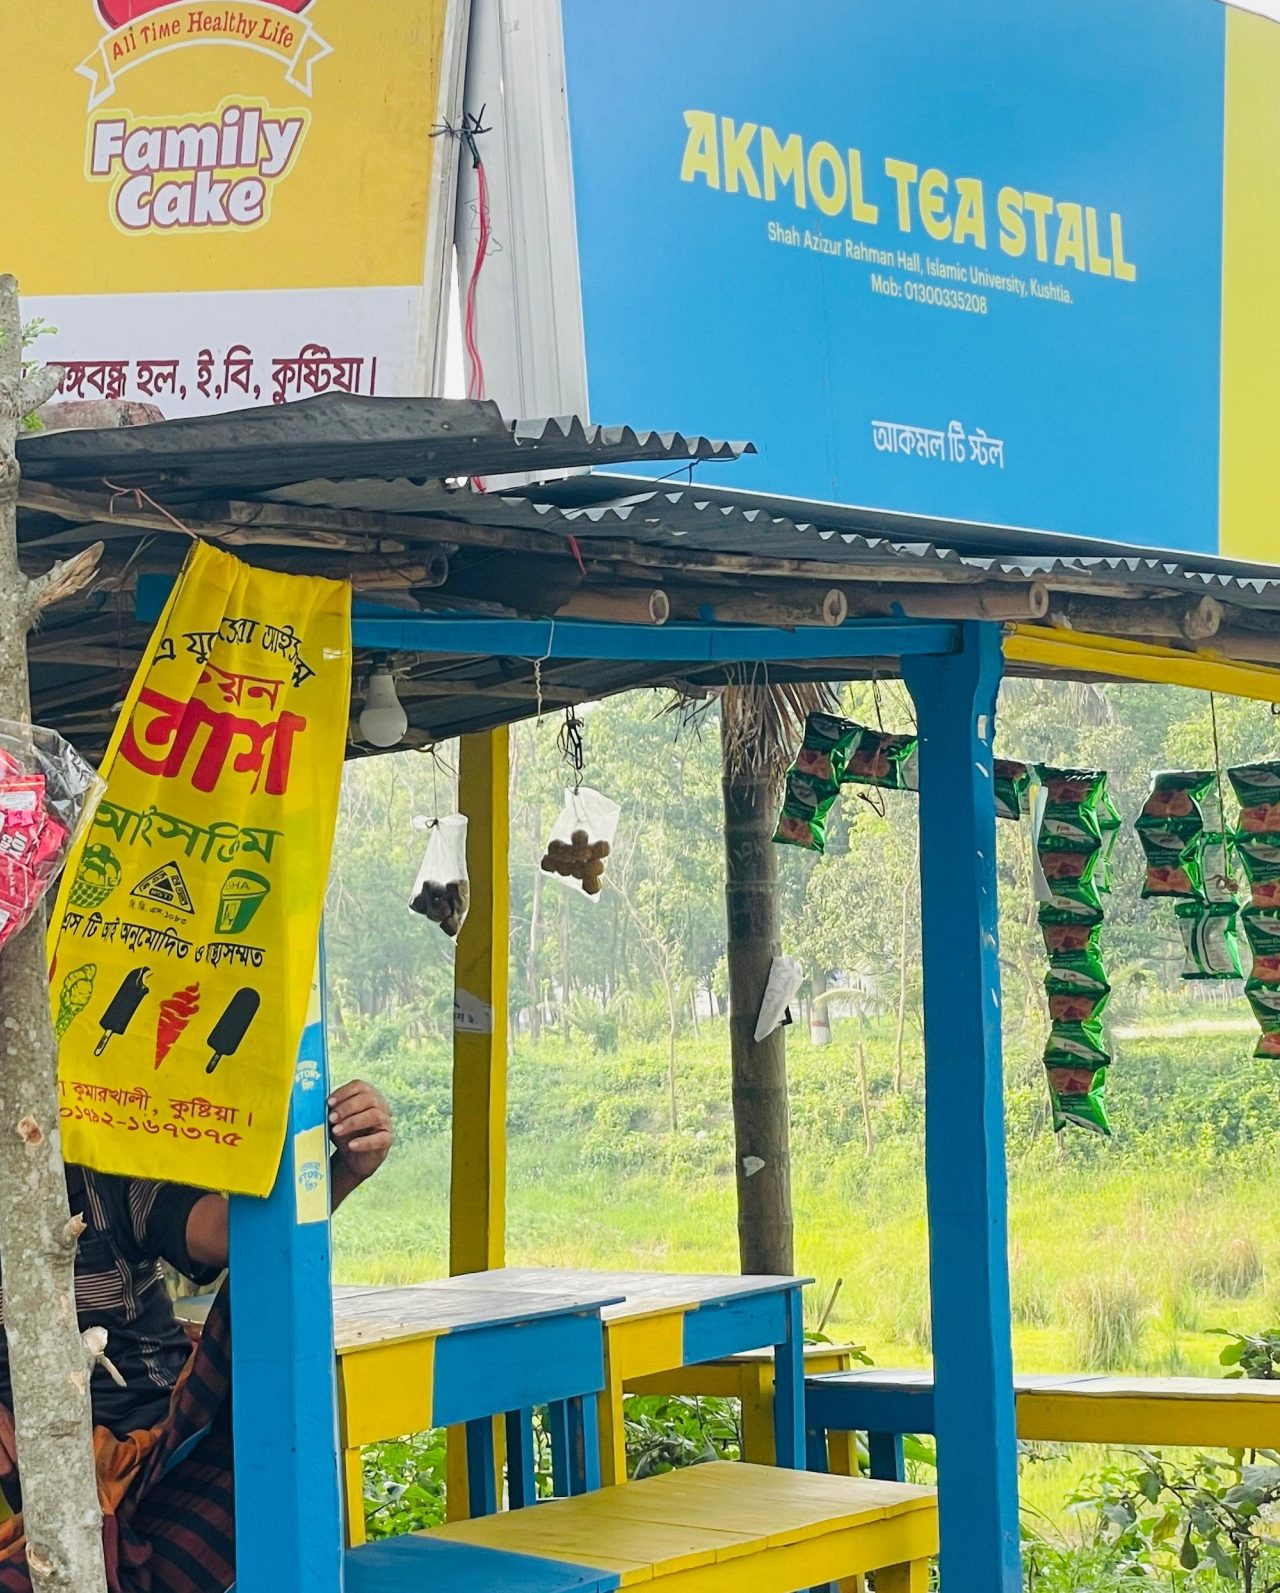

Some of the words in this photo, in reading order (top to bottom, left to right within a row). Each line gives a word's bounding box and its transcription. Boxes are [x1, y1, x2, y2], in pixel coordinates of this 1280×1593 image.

[112, 27, 136, 60] All
[140, 19, 180, 44] Time
[187, 10, 257, 39] Healthy
[259, 18, 294, 48] Life
[92, 106, 303, 177] Family
[115, 169, 266, 229] Cake
[679, 109, 879, 226] AKMOL
[885, 157, 988, 251] TEA
[998, 185, 1137, 282] STALL
[767, 222, 801, 247] Shah
[803, 229, 842, 256] Azizur
[844, 239, 895, 267] Rahman
[897, 250, 924, 276] Hall,
[926, 256, 969, 283] Islamic
[970, 265, 1028, 298] University,
[1030, 279, 1074, 305] Kushtia.
[871, 273, 902, 298] Mob:
[904, 281, 988, 314] 01300335208
[136, 358, 187, 400] হল,
[872, 419, 946, 462] আকমল
[948, 420, 966, 463] টি
[970, 425, 1004, 469] স্টল
[120, 921, 194, 959] অনুমোদিত
